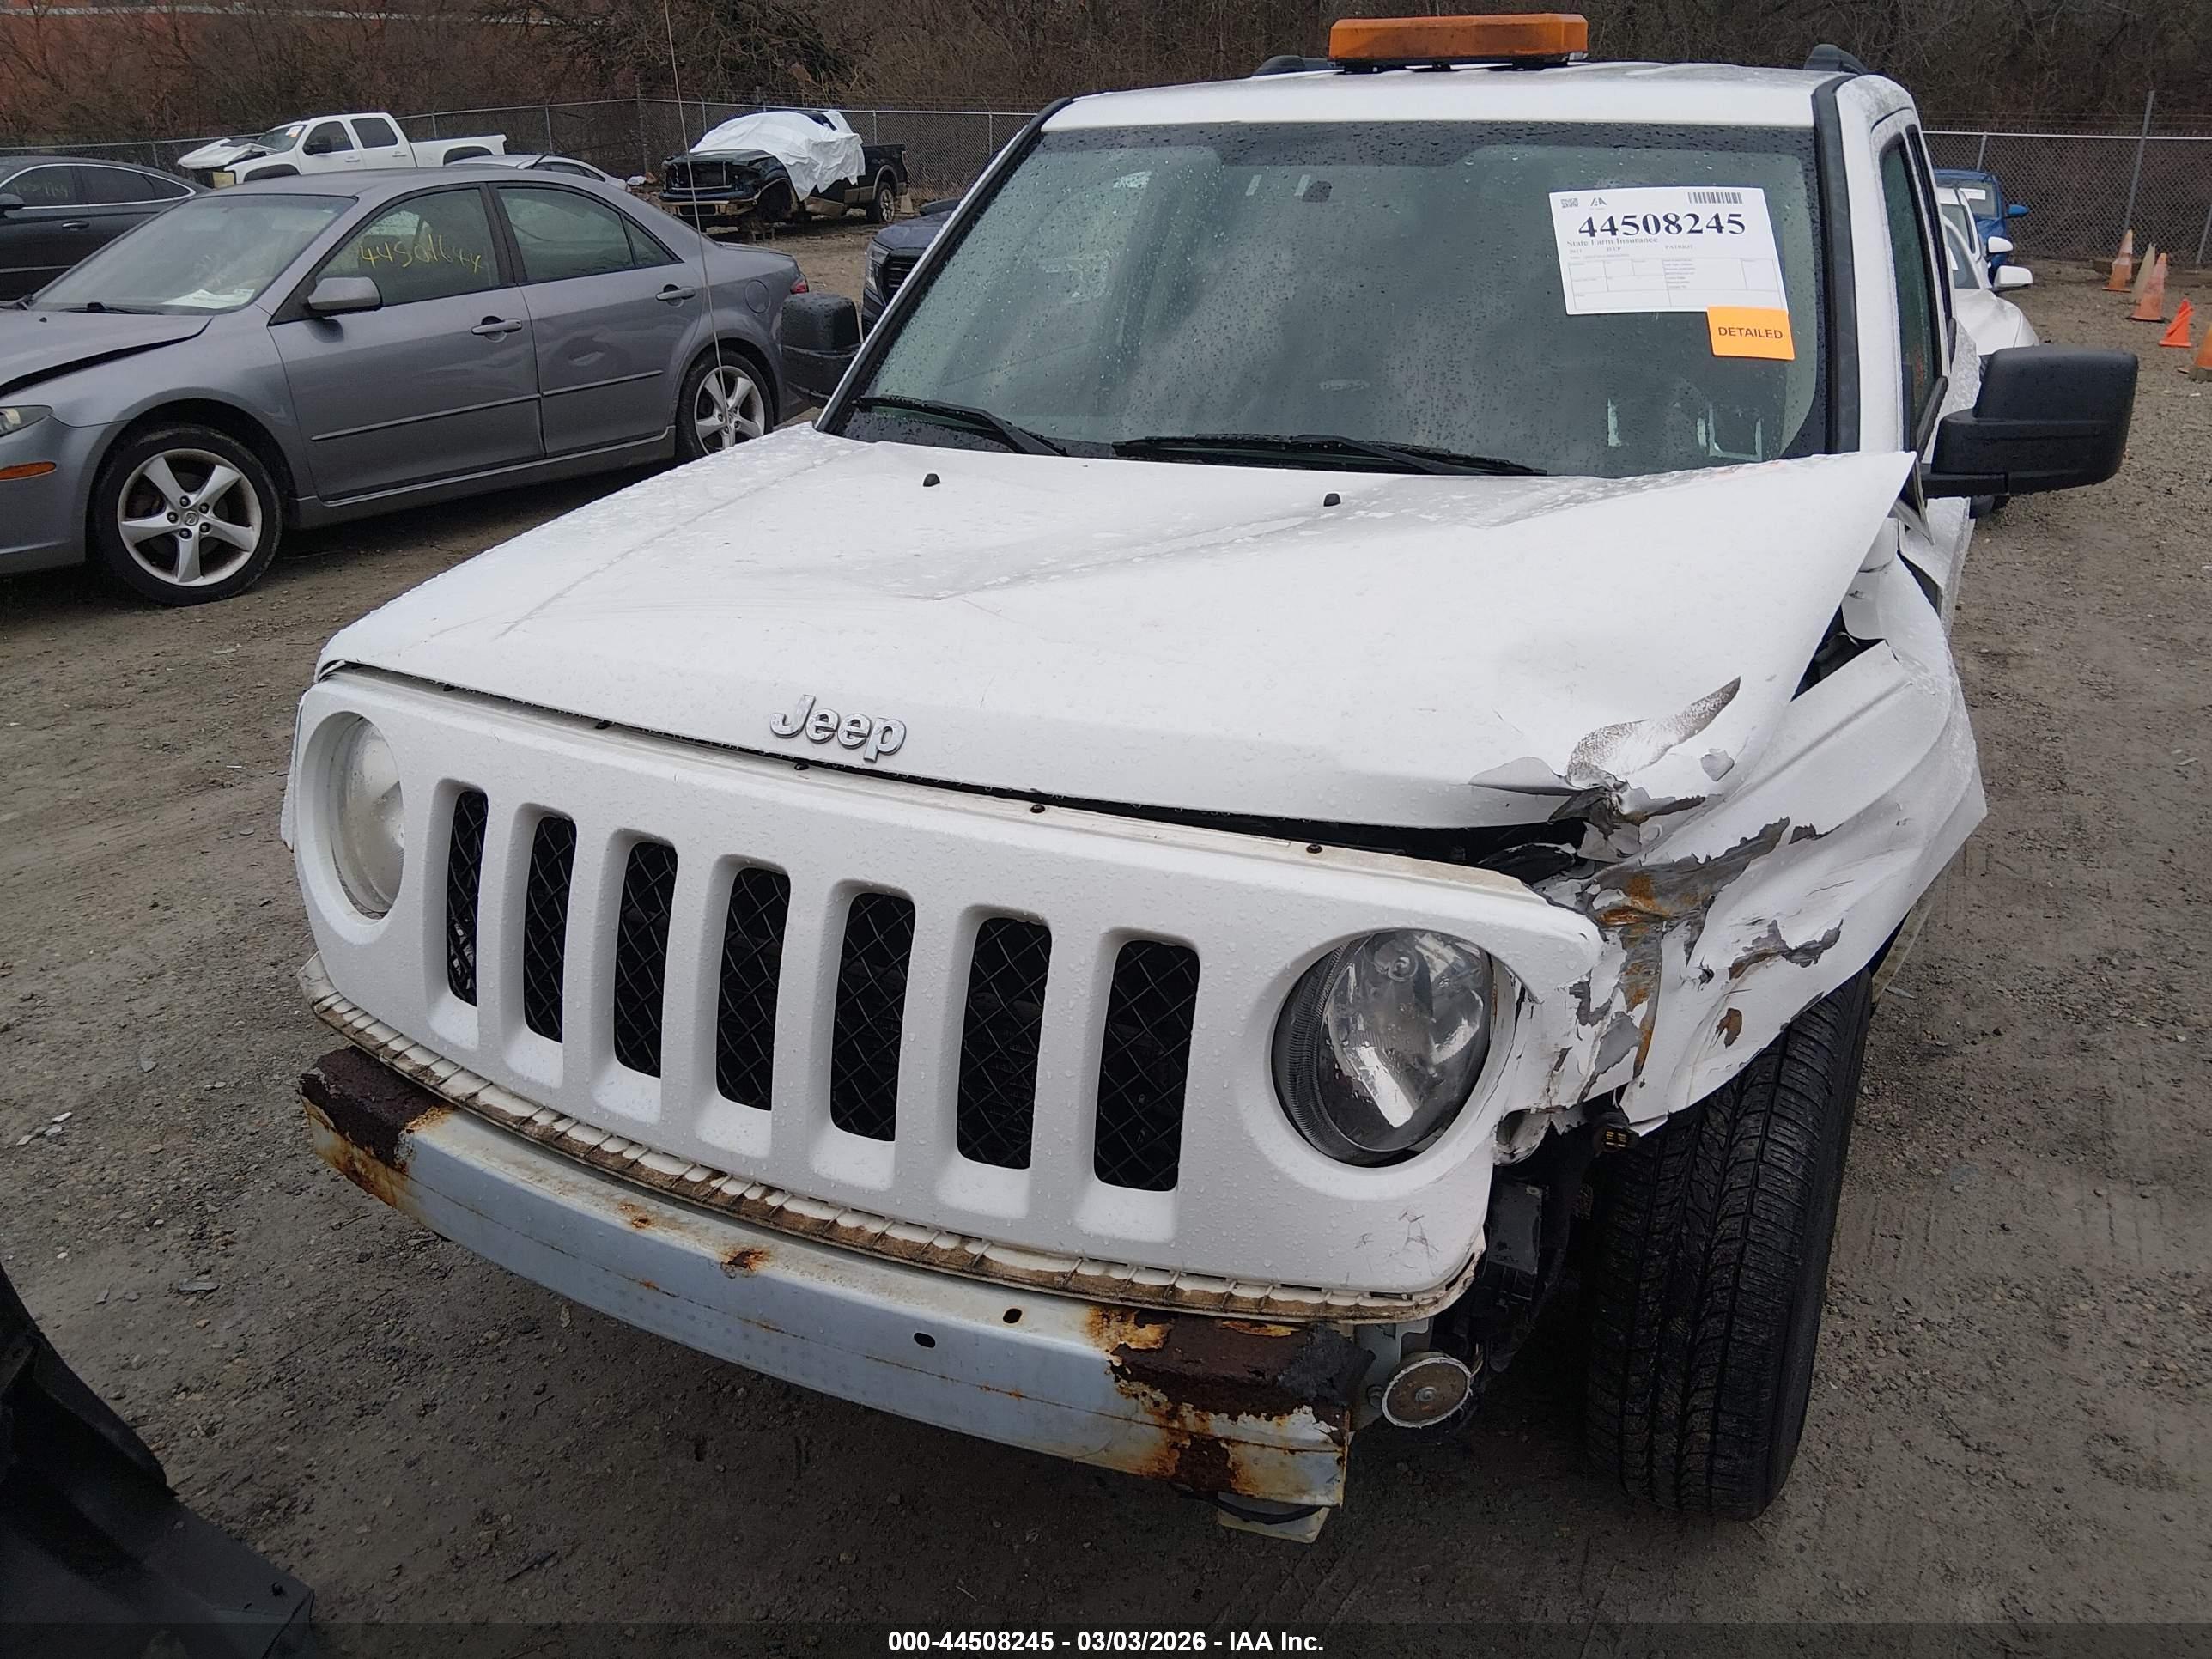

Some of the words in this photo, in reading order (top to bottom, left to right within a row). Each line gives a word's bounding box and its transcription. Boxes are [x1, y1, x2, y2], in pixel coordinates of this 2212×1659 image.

[1578, 212, 1746, 238] 44508245
[1591, 238, 1614, 246] Farm
[1616, 236, 1658, 245] Insurance
[1718, 326, 1784, 339] DETAILED
[769, 693, 907, 763] Jeep
